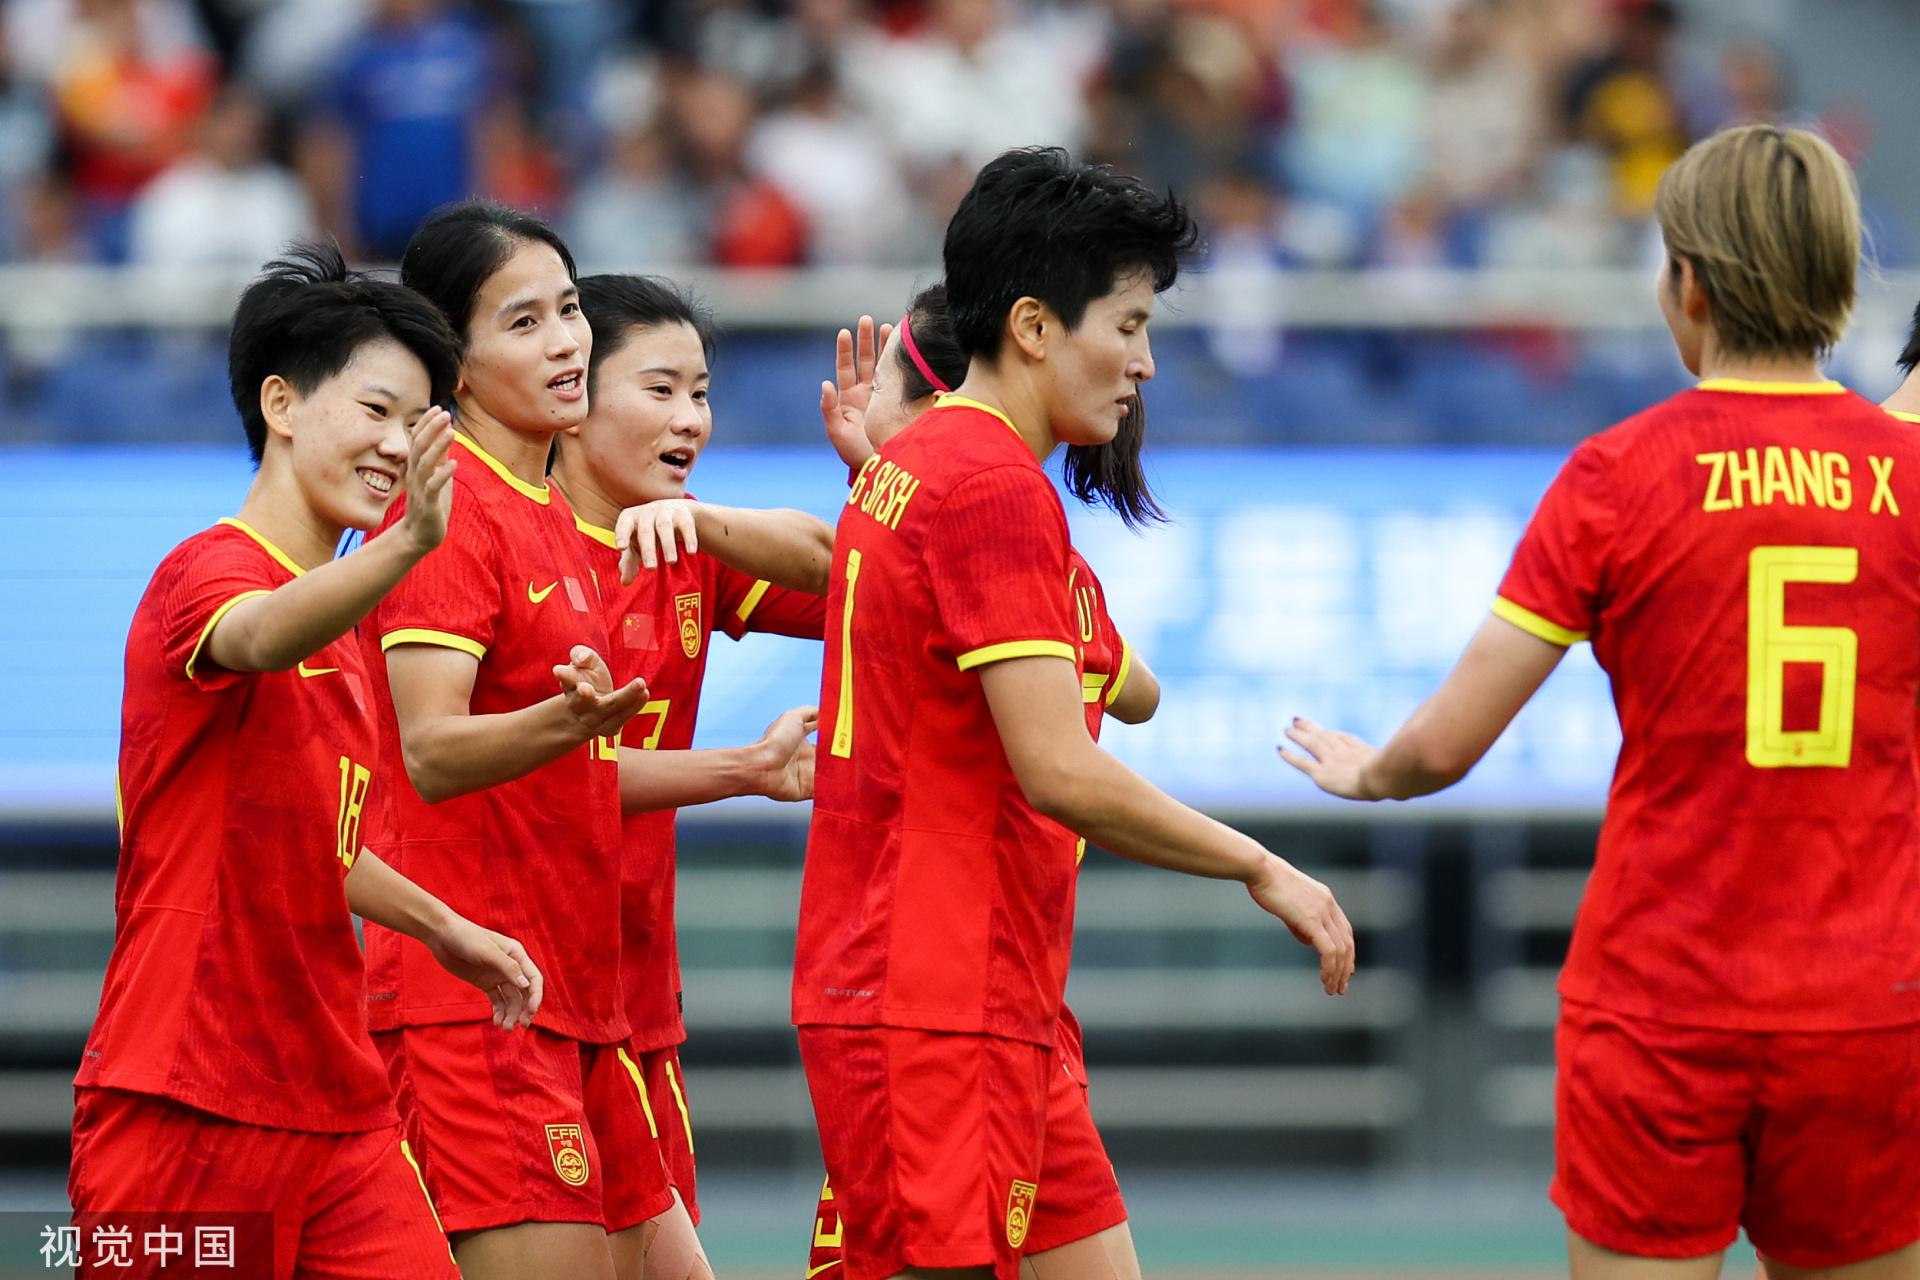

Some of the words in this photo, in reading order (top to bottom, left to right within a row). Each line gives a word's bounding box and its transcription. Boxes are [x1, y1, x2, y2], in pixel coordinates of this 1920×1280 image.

[861, 460, 921, 531] SHSH
[1695, 446, 1852, 512] ZHANG
[1868, 455, 1900, 516] X
[677, 597, 699, 611] CFA
[830, 548, 862, 759] 1
[1746, 545, 1859, 768] 6
[337, 755, 371, 869] 18
[549, 1128, 579, 1140] CFA
[1012, 1184, 1034, 1200] CFA
